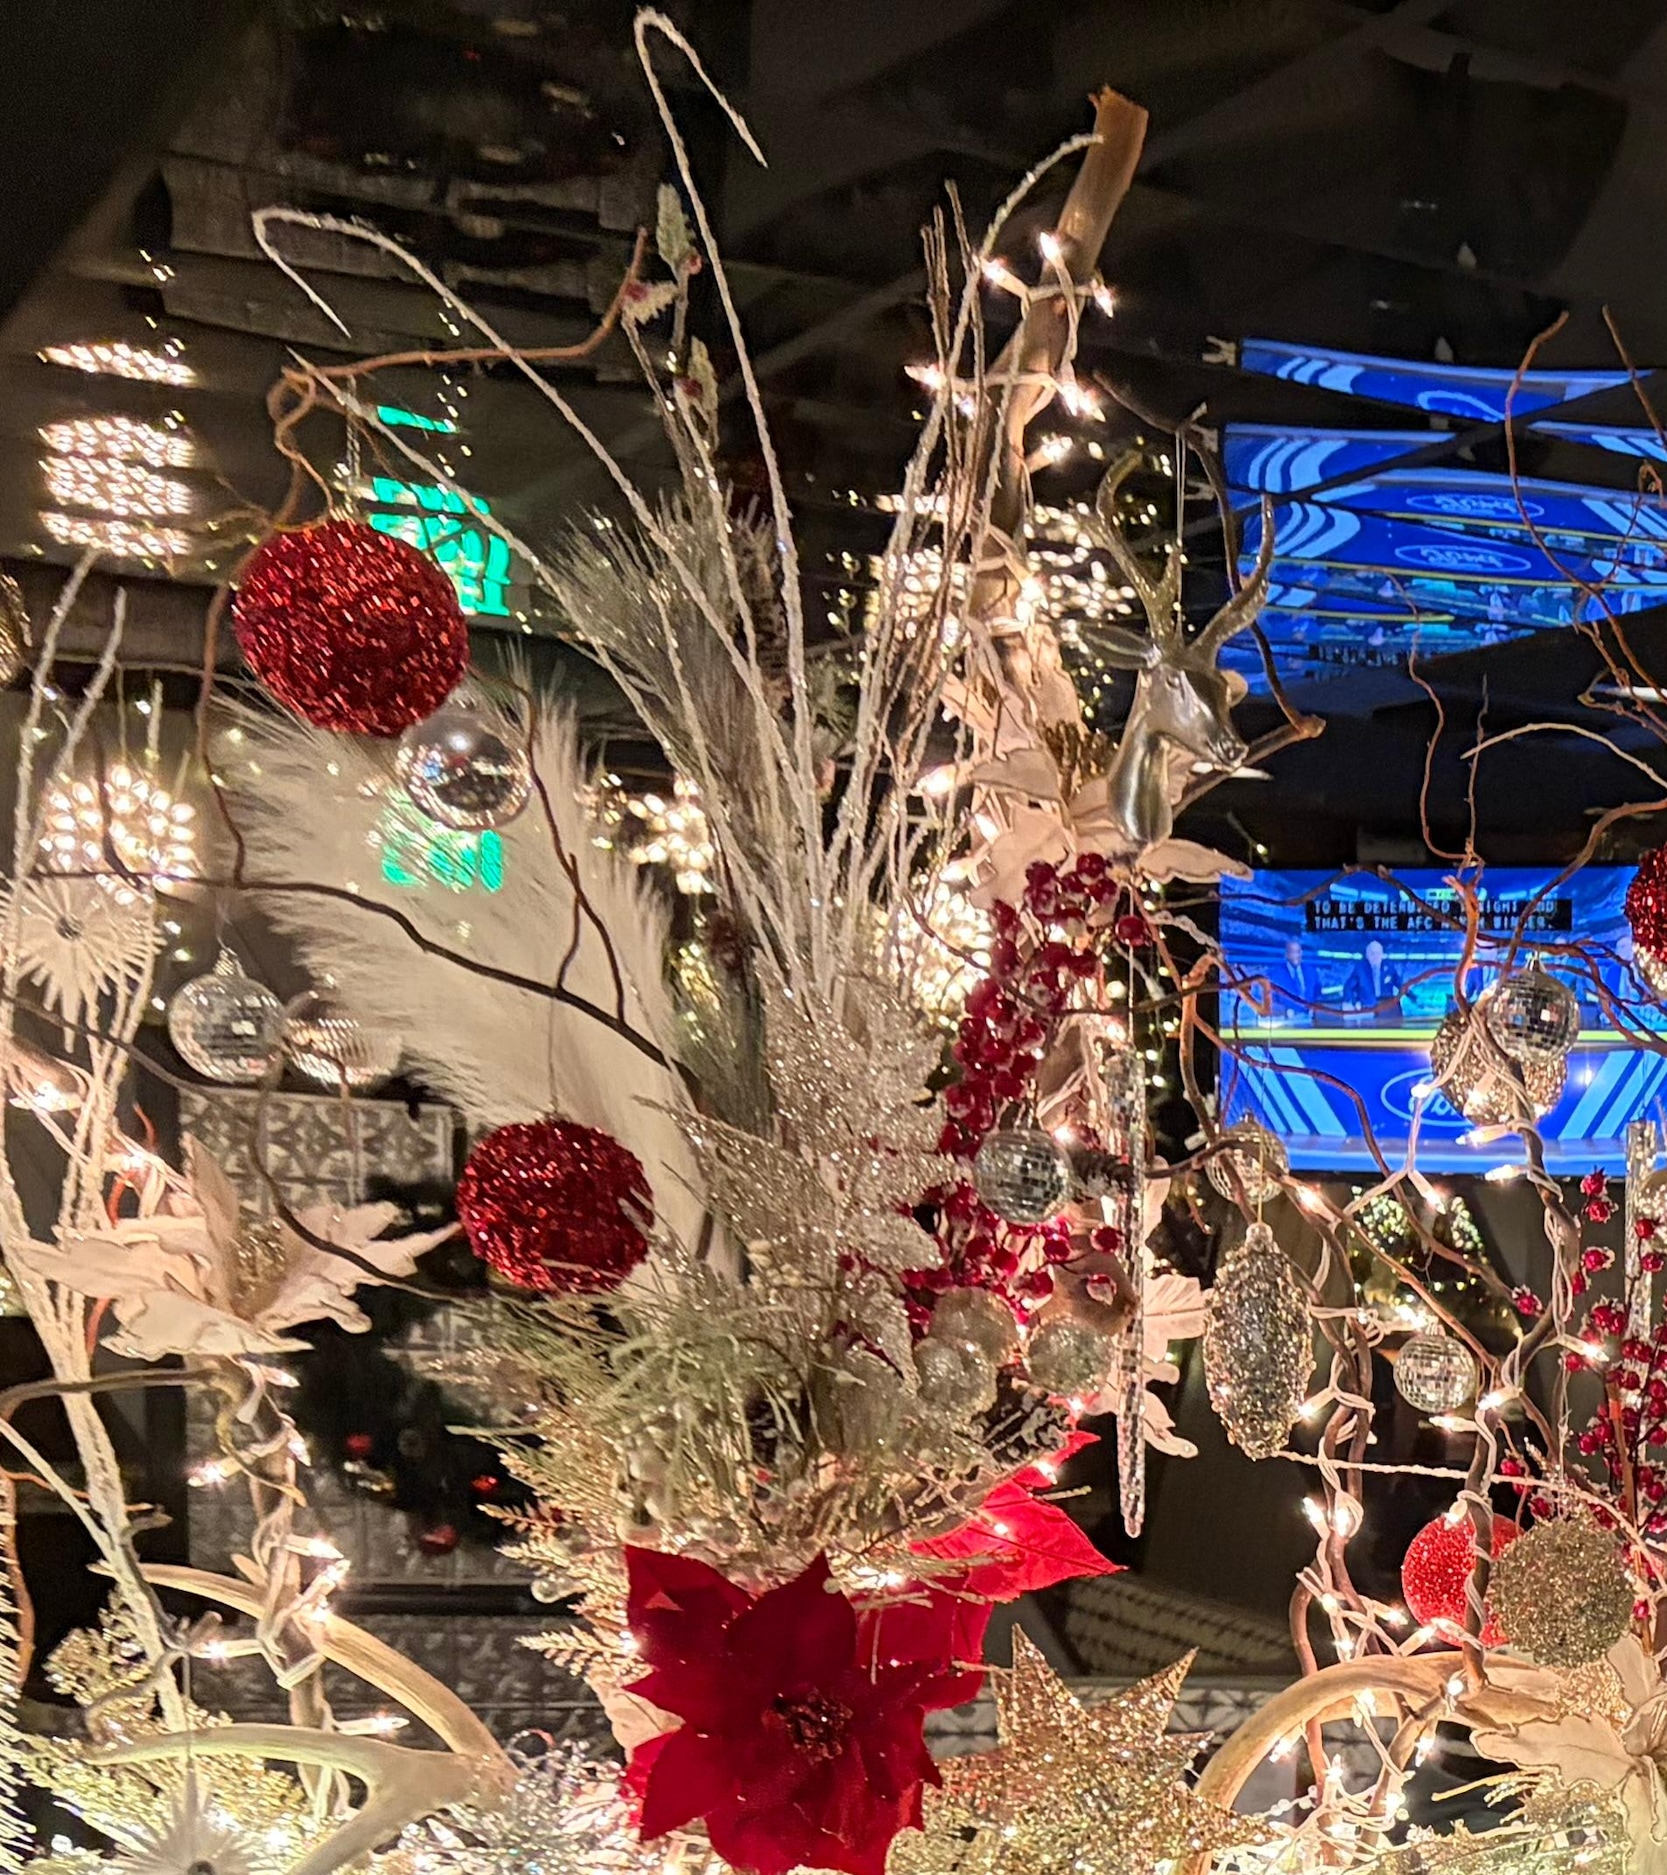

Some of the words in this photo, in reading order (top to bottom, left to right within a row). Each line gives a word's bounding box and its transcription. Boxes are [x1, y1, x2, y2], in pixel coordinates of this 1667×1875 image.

[1315, 900, 1331, 914] TO
[1339, 901, 1355, 914] BE
[1460, 900, 1518, 913] TNIGHT
[1315, 916, 1364, 929] THAT'S
[1374, 916, 1398, 929] THE
[1407, 916, 1433, 930] AFC
